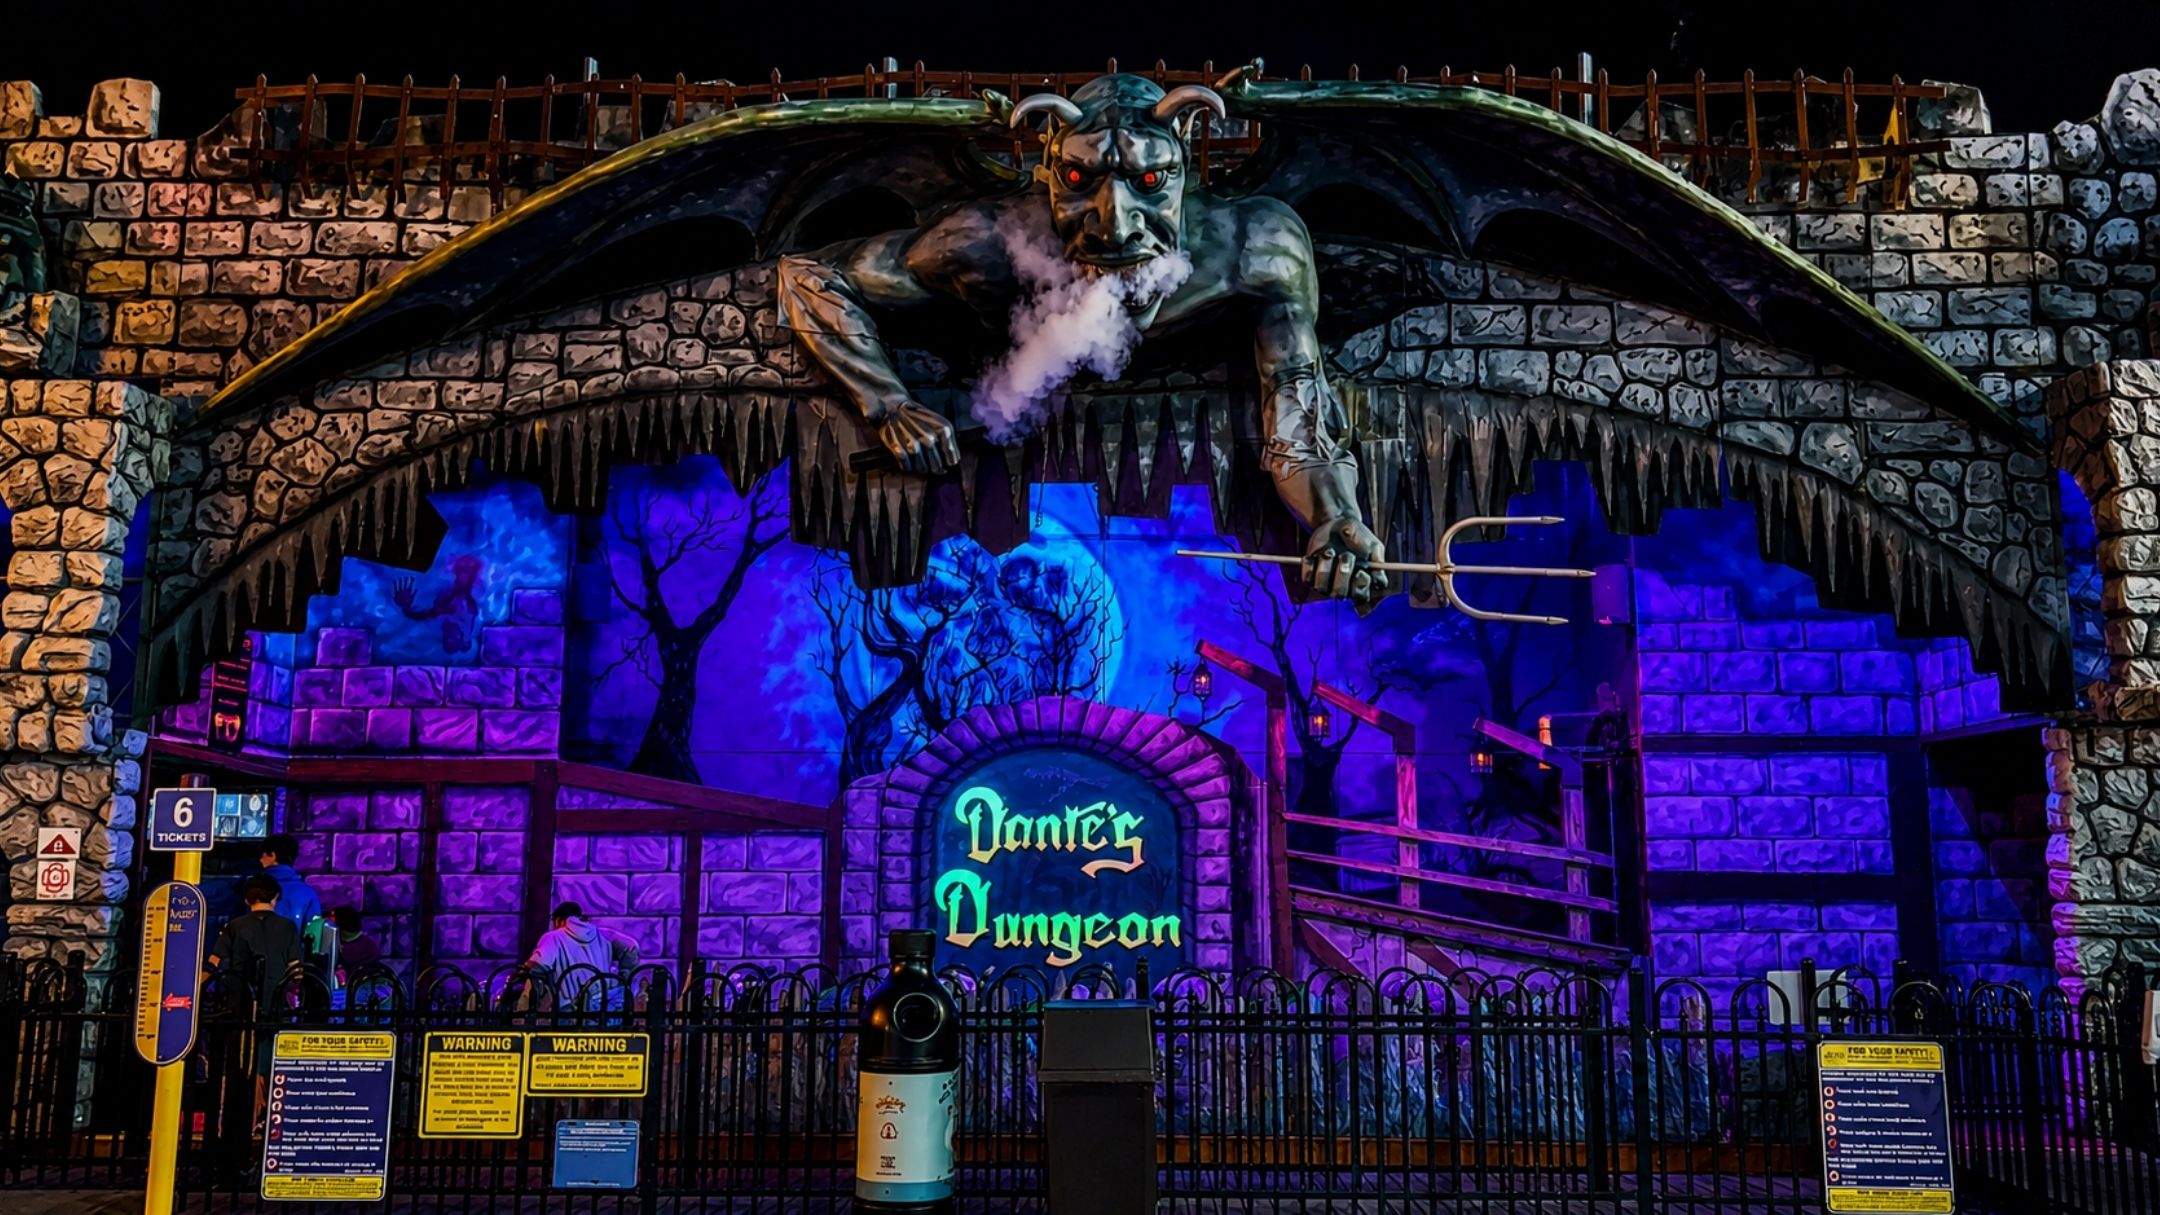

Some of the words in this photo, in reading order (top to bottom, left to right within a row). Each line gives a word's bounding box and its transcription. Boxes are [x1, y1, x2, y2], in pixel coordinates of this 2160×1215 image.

[174, 797, 193, 827] 6
[157, 832, 206, 842] TICKETS
[955, 786, 1144, 878] Dante's
[934, 869, 1181, 966] Dungeon
[442, 1037, 512, 1050] WARNING
[552, 1038, 627, 1052] WARNING
